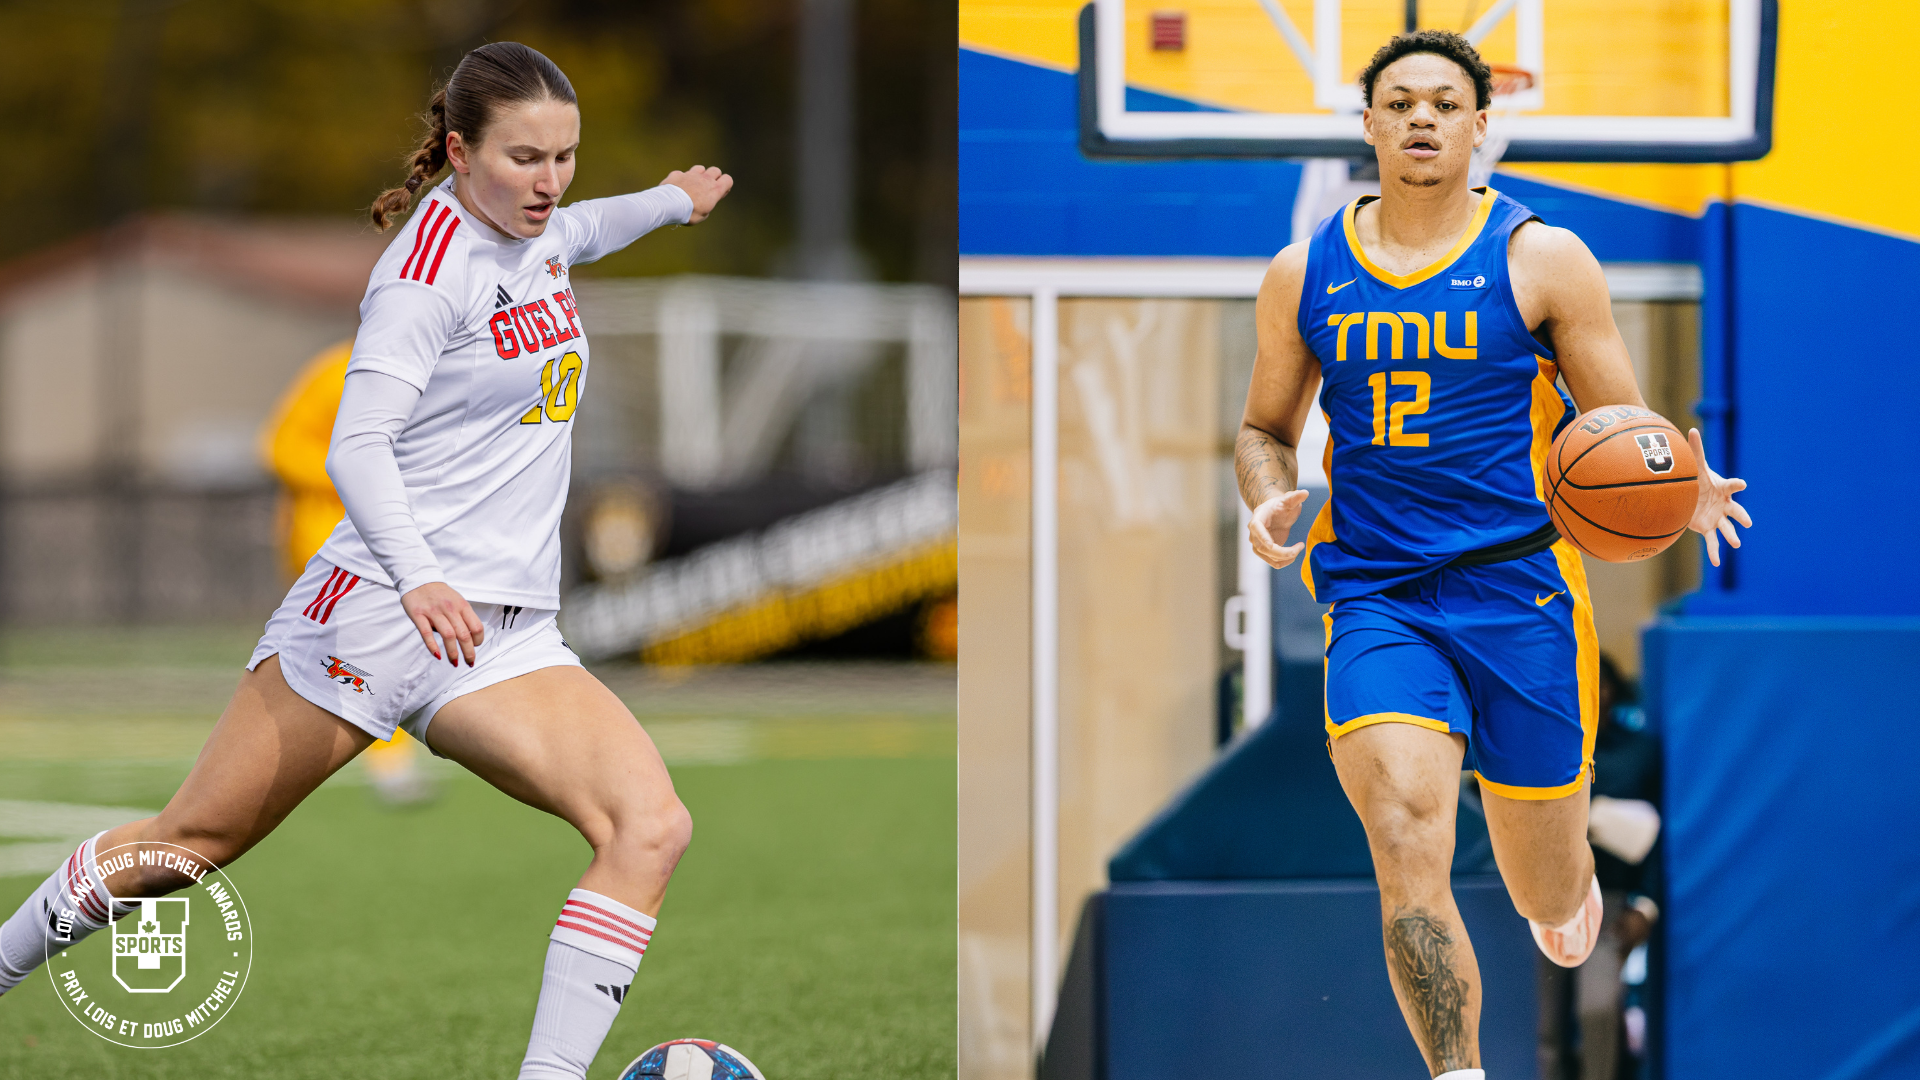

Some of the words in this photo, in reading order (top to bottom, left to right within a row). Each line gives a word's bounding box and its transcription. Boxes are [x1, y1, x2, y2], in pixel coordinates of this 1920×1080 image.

[1451, 279, 1472, 287] BMO
[1327, 311, 1478, 361] TMU
[520, 351, 583, 425] 10
[1368, 371, 1431, 447] 12
[1643, 447, 1671, 458] SPORTS
